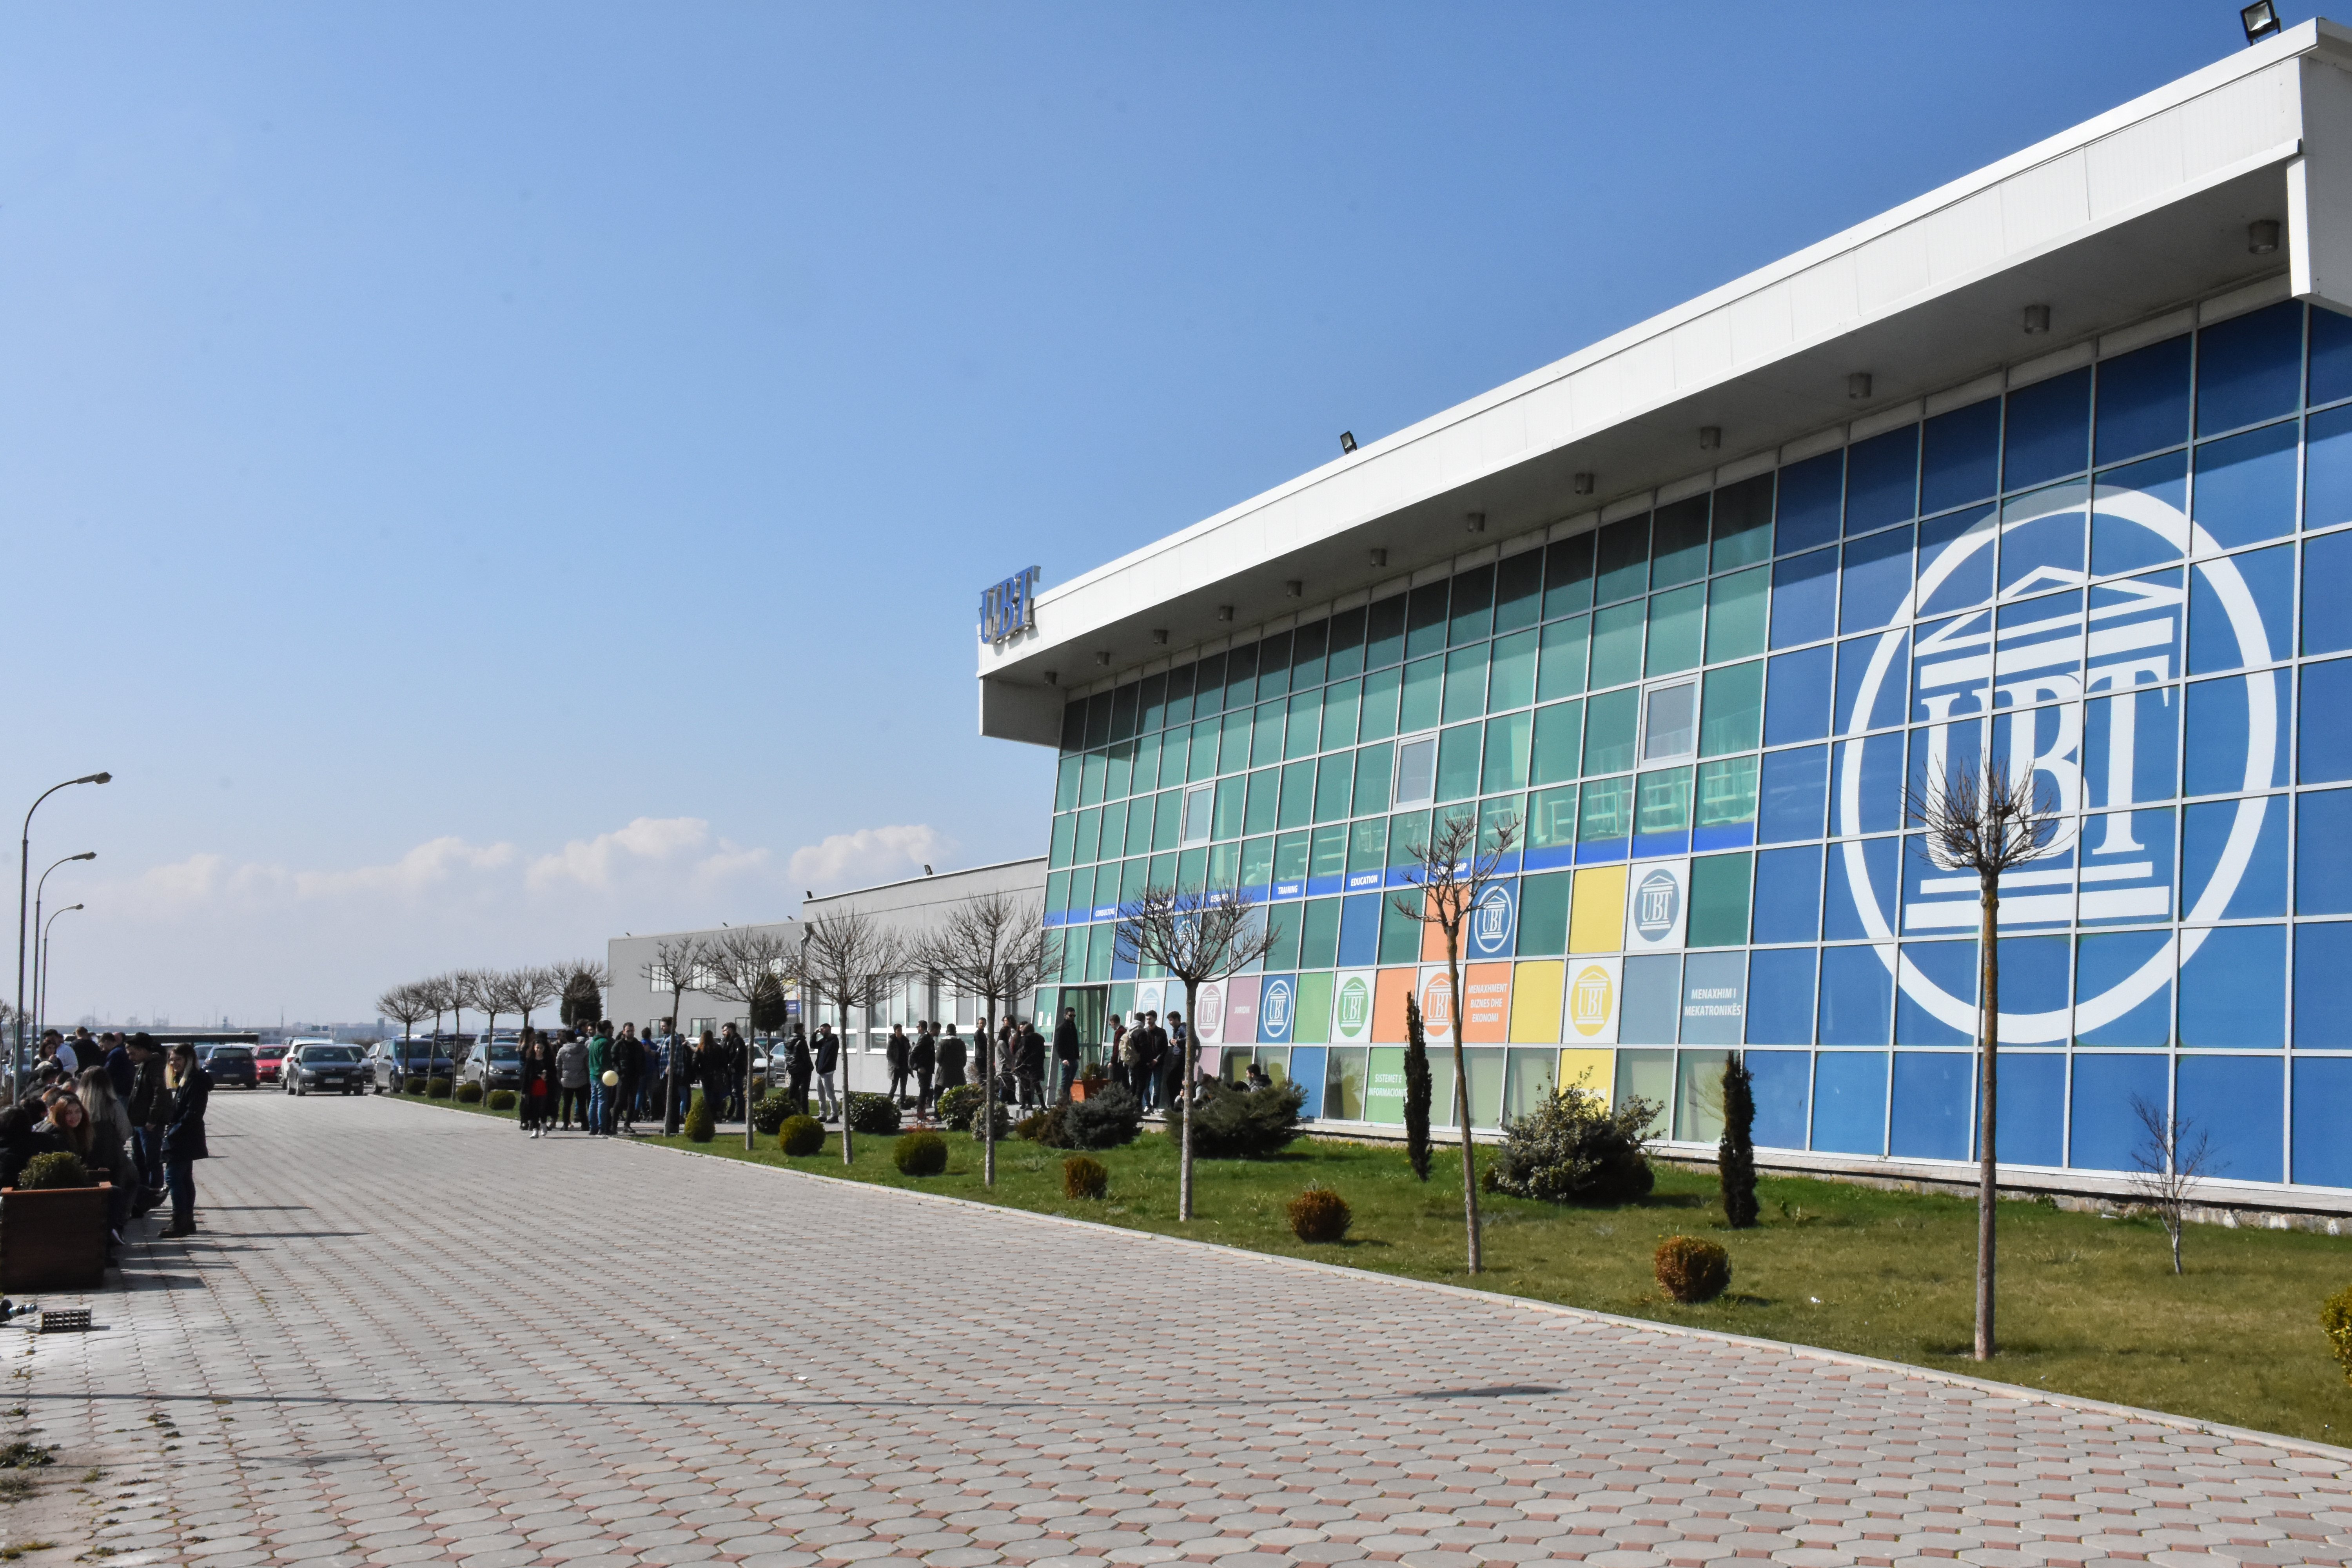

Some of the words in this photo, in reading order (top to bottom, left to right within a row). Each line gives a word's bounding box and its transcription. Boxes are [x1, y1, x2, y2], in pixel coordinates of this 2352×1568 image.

[981, 565, 1041, 644] UBT
[1921, 655, 2169, 871] UBT
[1434, 862, 1467, 875] EADSHIP
[1350, 875, 1378, 886] EDUCATION
[1278, 885, 1298, 894] TRAINING
[1095, 908, 1115, 917] CONSULTING
[1642, 891, 1672, 921] UBT
[1483, 908, 1504, 932] UBT
[1468, 983, 1508, 994] MENAXHMENT
[1691, 988, 1732, 999] MENAXHIM
[1343, 996, 1364, 1020] UBT
[1428, 993, 1451, 1018] UBT
[1470, 999, 1490, 1008] BIZNES
[1491, 998, 1503, 1007] DHE
[1578, 988, 1606, 1016] UBT
[1201, 1001, 1218, 1022] UBT
[1270, 1000, 1286, 1019] UBT
[1684, 1003, 1741, 1016] MEKATRONIKËS
[1472, 1013, 1499, 1022] EKONOMI
[1375, 1074, 1398, 1082] SISTEMET
